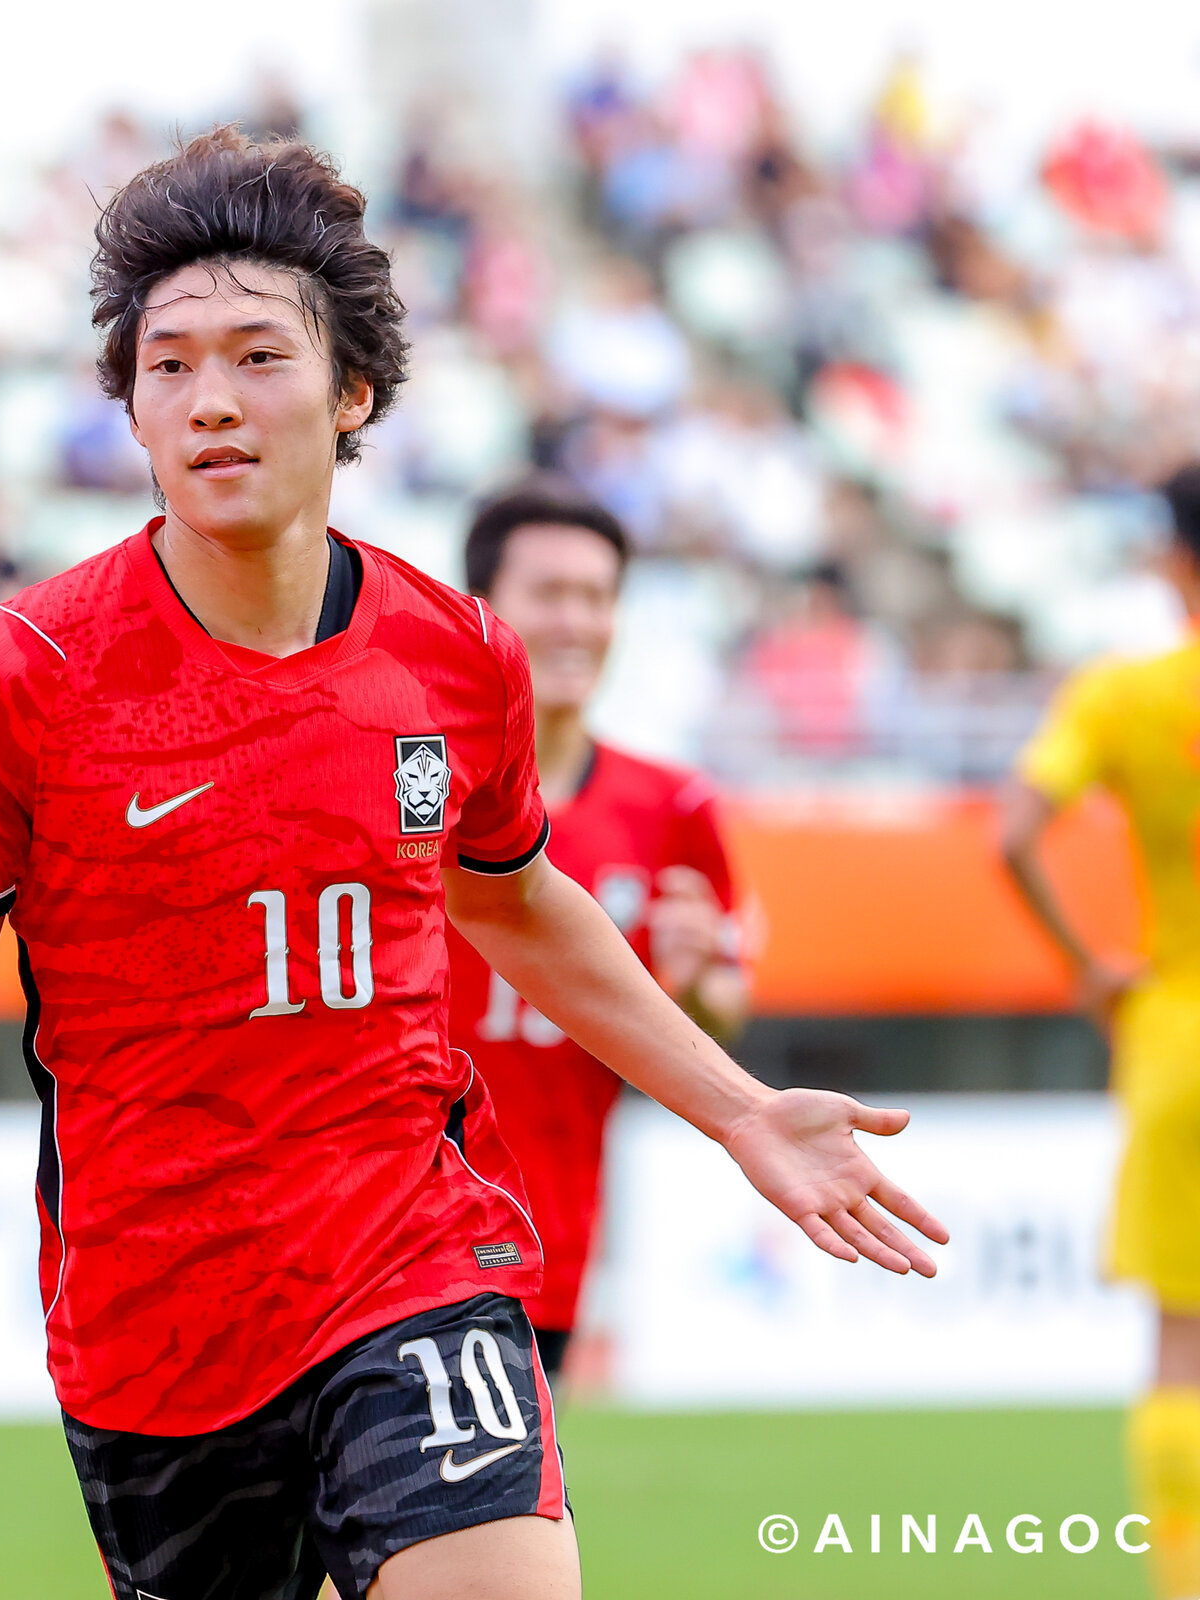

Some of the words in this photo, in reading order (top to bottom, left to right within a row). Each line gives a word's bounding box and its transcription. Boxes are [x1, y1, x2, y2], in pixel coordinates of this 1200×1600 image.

[395, 839, 440, 859] KOREA
[246, 881, 376, 1020] 10
[397, 1327, 529, 1453] 10
